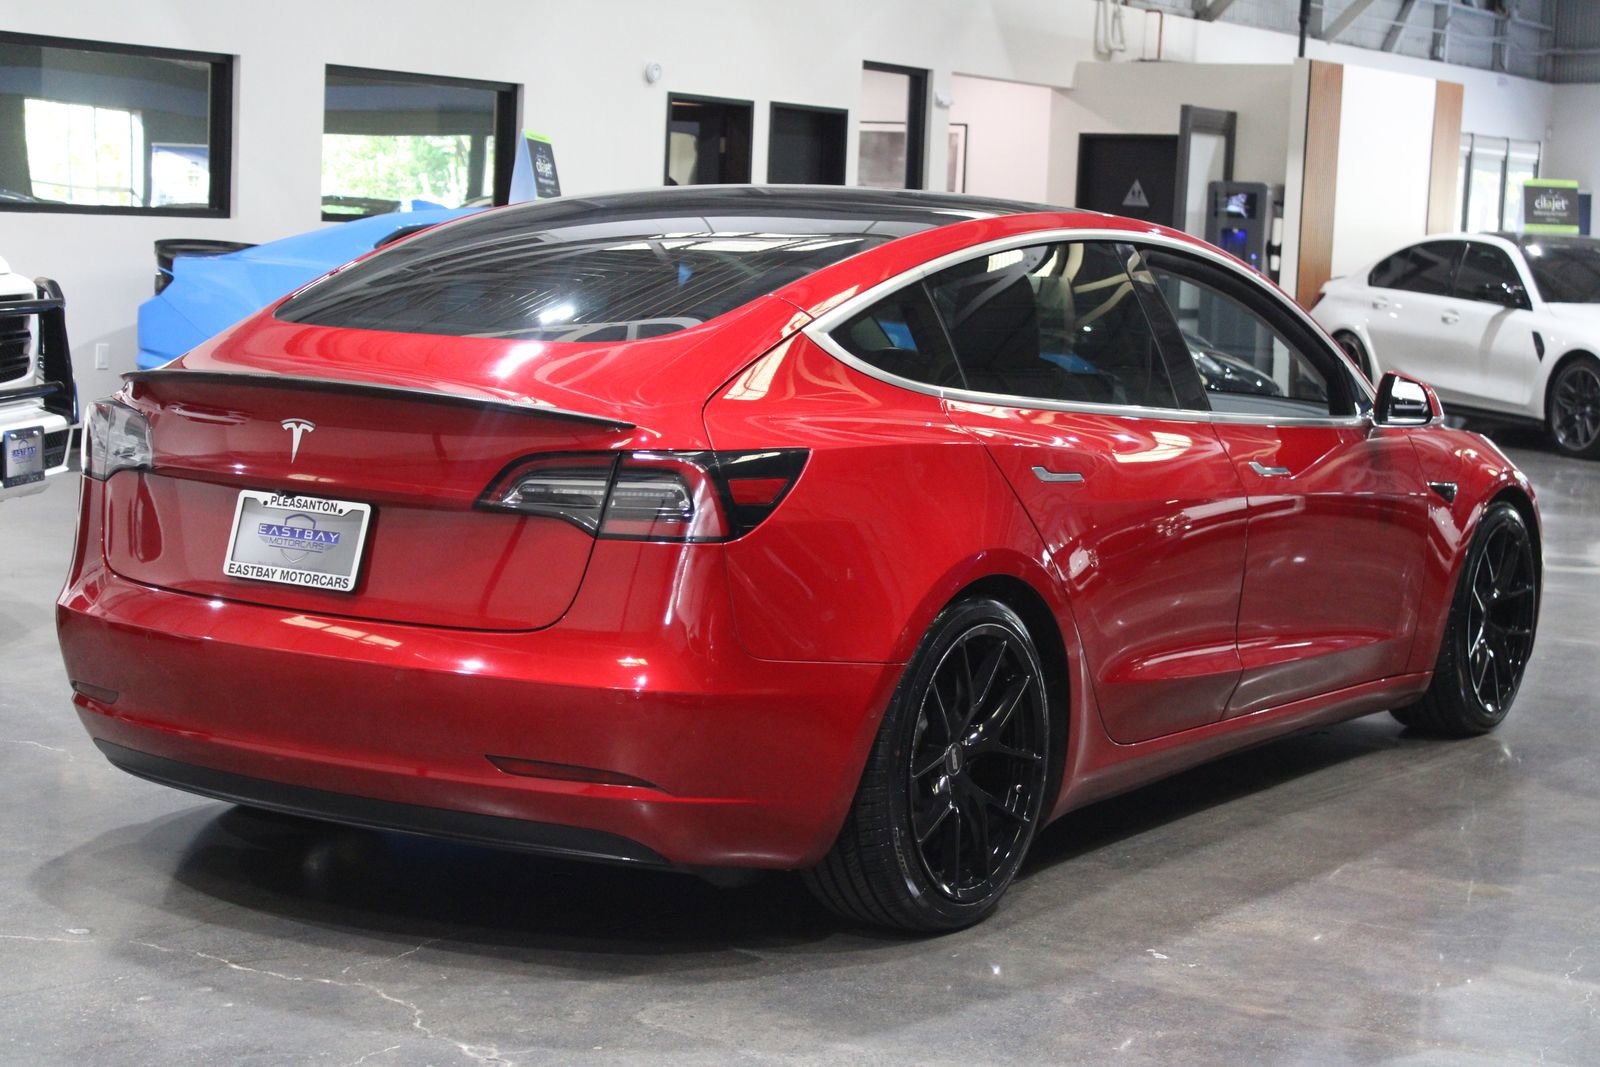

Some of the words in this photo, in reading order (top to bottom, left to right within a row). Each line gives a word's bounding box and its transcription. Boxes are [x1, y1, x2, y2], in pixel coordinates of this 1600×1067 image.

[270, 496, 338, 513] PLEASANTON
[259, 525, 340, 543] EASTBAY
[268, 537, 325, 550] MOTORCARS
[228, 563, 278, 579] EASTBAY
[279, 570, 349, 589] MOTORCARS
